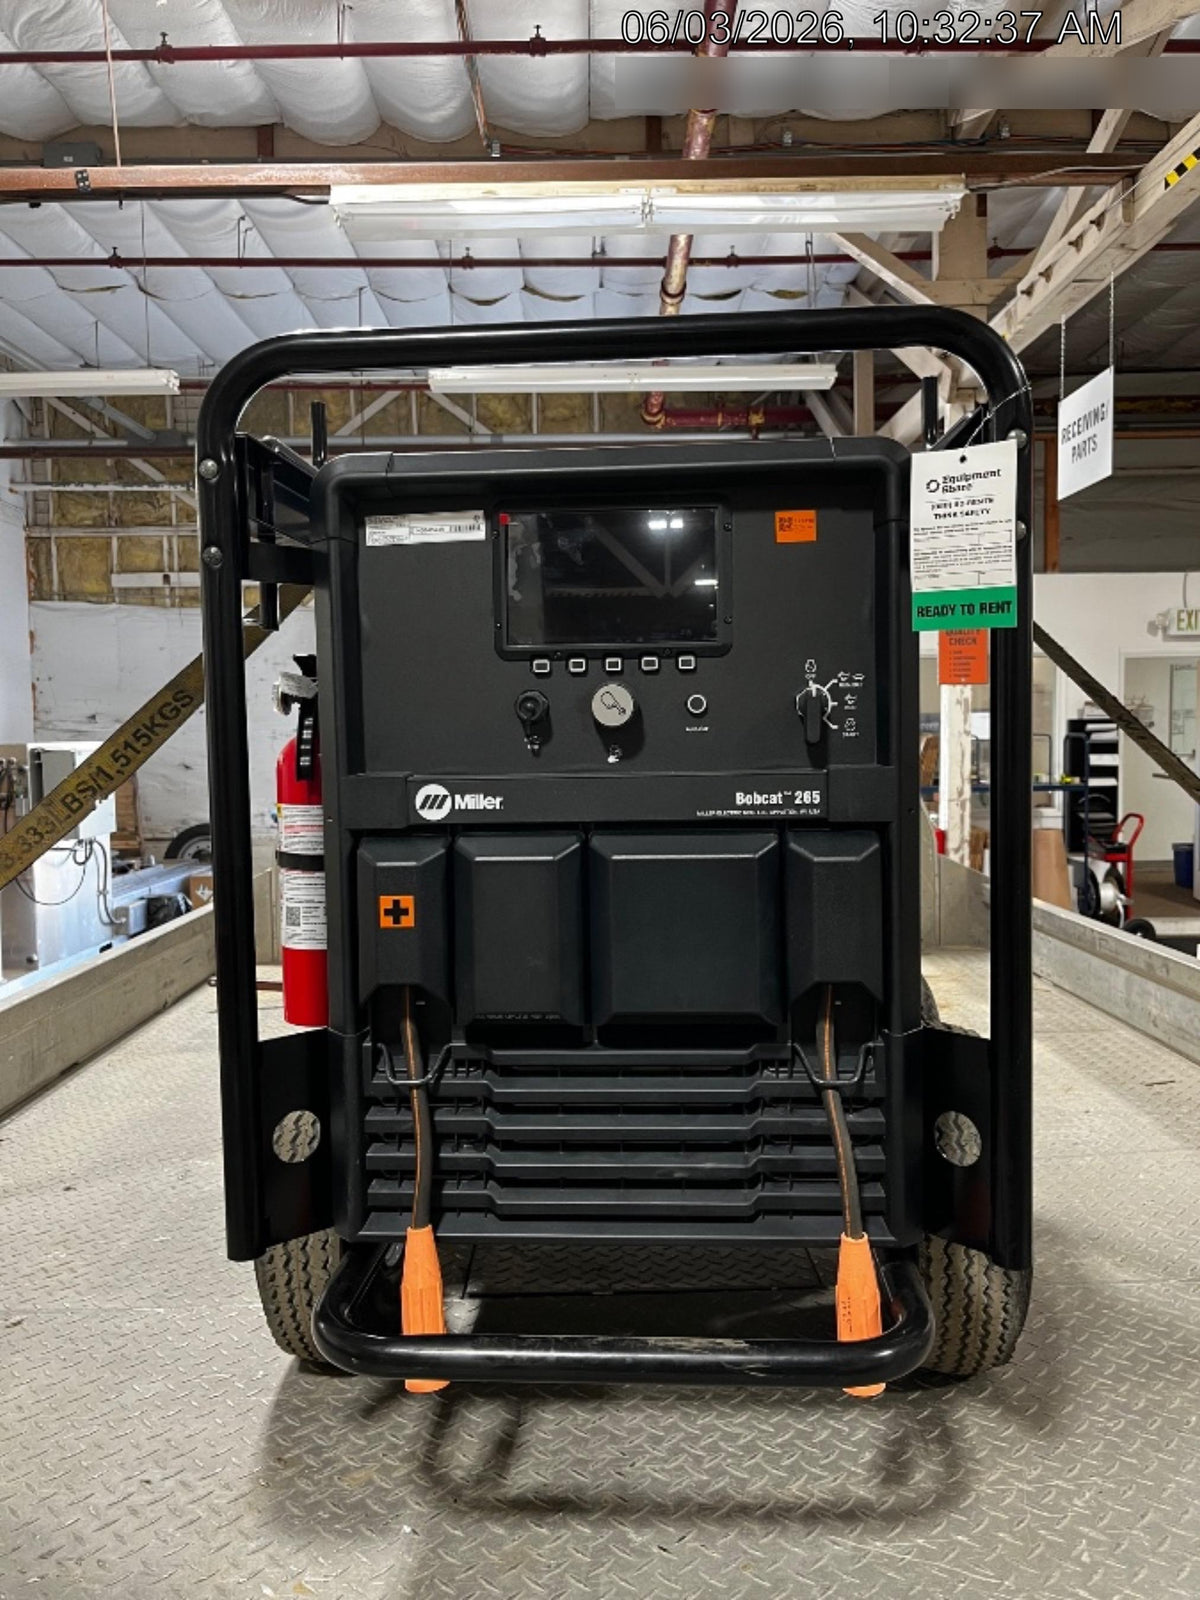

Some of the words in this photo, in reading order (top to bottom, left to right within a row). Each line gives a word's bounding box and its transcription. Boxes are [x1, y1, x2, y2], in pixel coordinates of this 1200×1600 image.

[1072, 433, 1098, 464] PARTS
[942, 468, 1001, 484] Equipment
[942, 483, 973, 494] Share
[917, 604, 957, 618] READY
[960, 602, 975, 616] TO
[979, 600, 1012, 615] RENT
[1177, 609, 1200, 631] EXI
[949, 637, 977, 646] CHECK
[454, 793, 503, 810] Miller
[794, 790, 820, 804] 265
